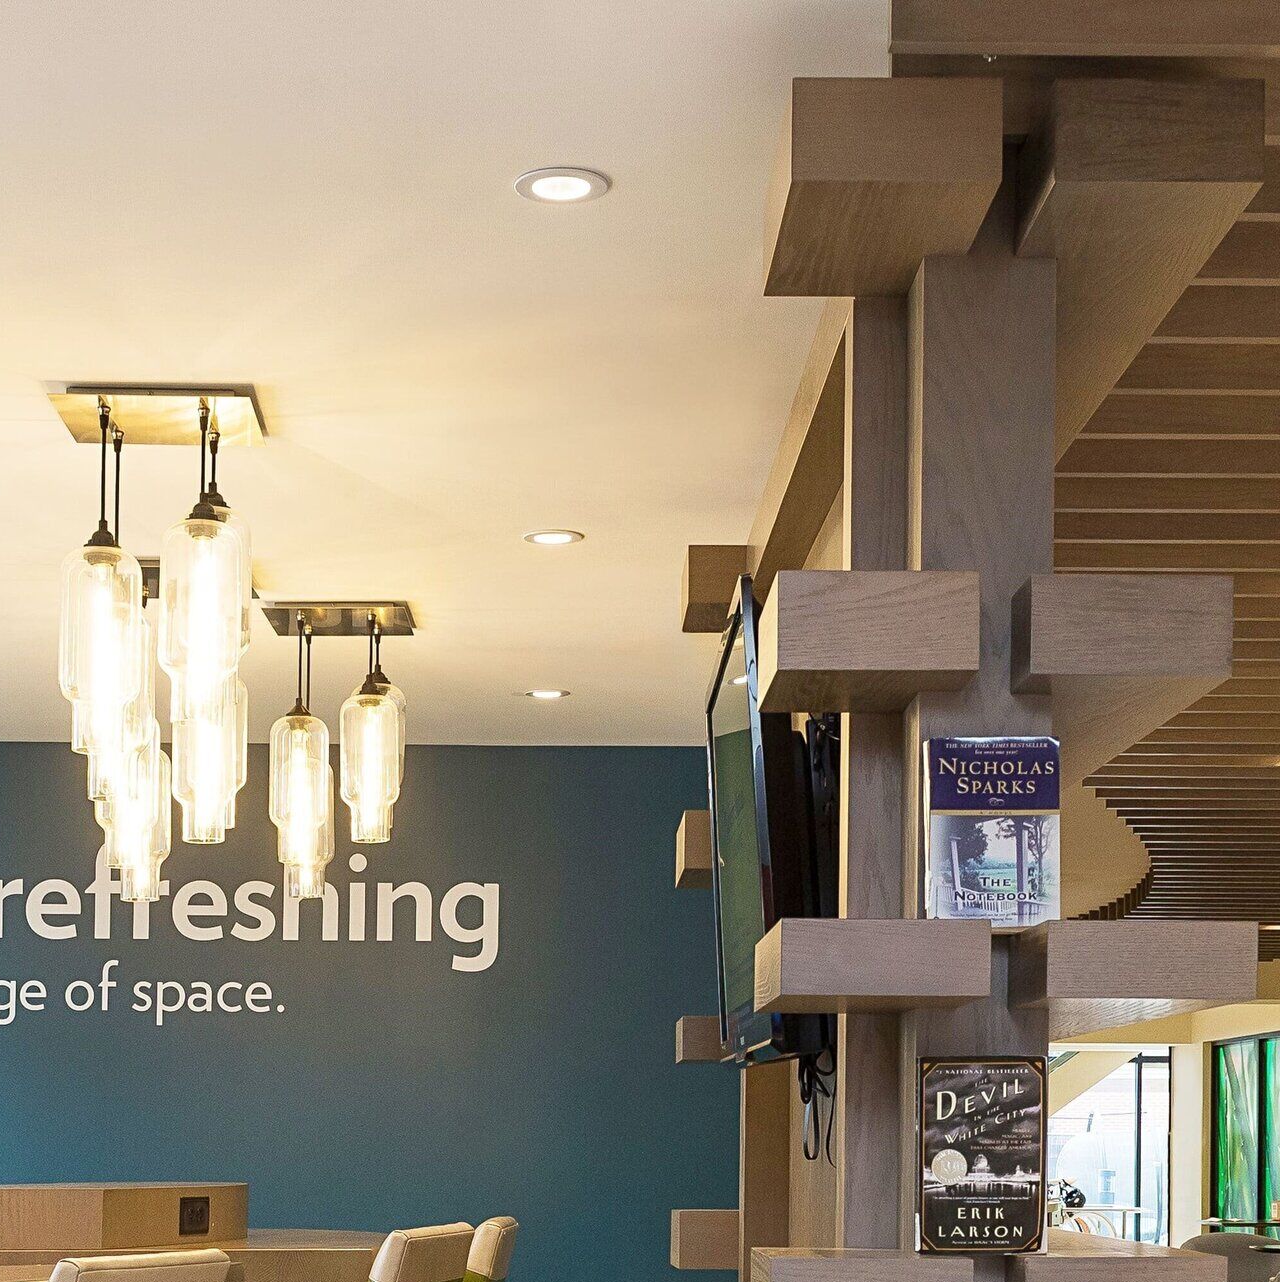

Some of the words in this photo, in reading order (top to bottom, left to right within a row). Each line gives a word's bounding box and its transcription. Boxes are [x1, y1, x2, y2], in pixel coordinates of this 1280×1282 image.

[938, 757, 1055, 775] NICHOLAS
[956, 777, 1036, 795] SPARKS
[980, 876, 1012, 887] THE
[954, 891, 1038, 901] NOTEBOOK
[63, 959, 119, 1012] of
[131, 980, 286, 1026] space.
[936, 1078, 1025, 1121] DEVIL
[944, 1123, 987, 1144] WHITE
[994, 1108, 1027, 1125] CITY
[957, 1207, 1005, 1220] ERIK
[938, 1225, 1023, 1238] LARSON
